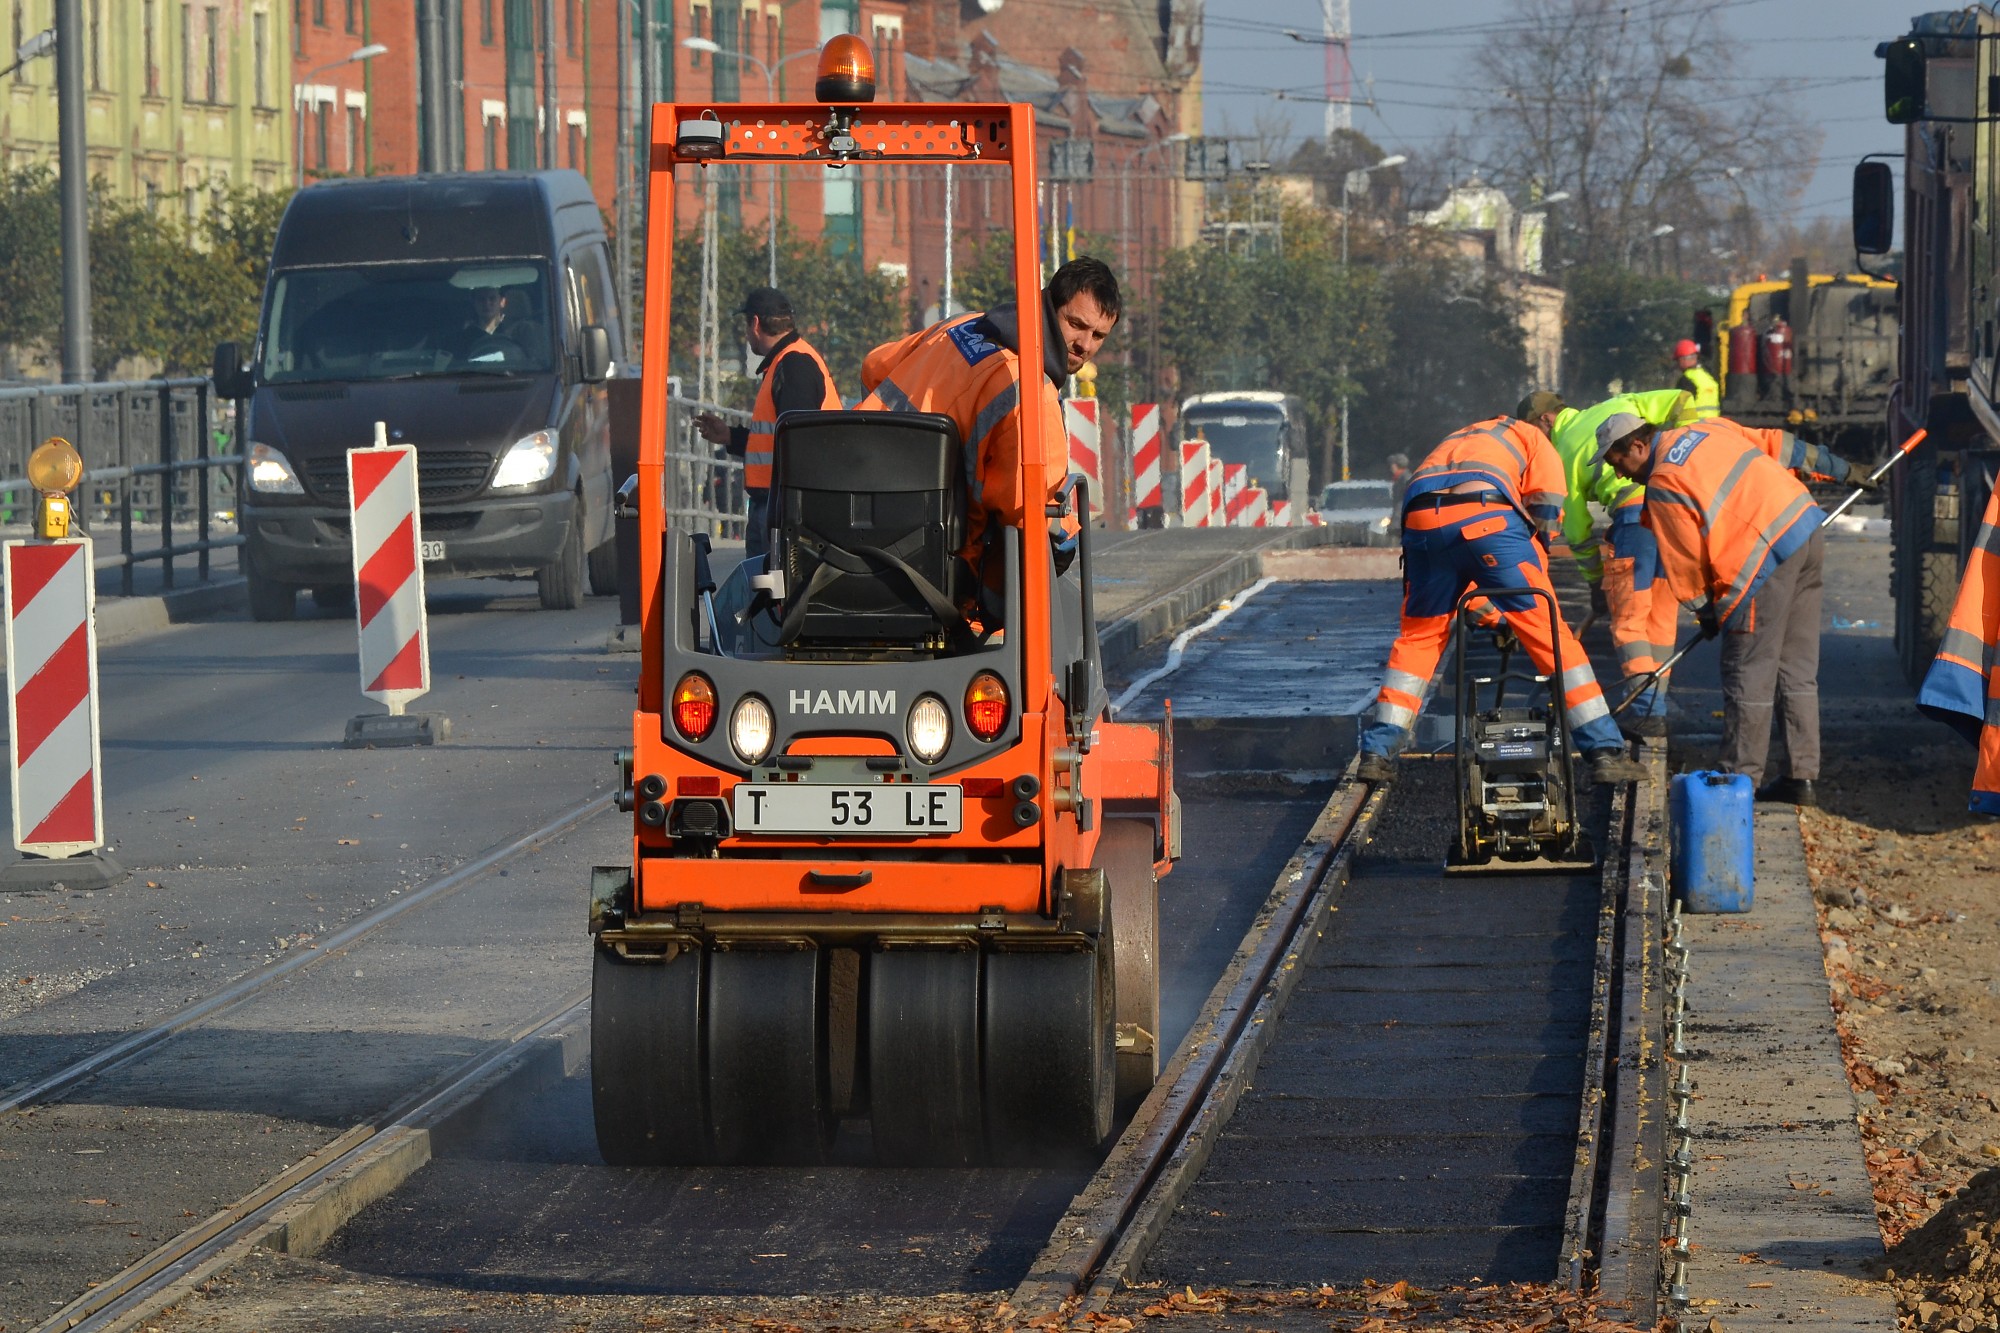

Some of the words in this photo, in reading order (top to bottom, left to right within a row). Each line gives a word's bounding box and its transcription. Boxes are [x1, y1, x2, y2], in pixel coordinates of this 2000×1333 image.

[789, 689, 896, 715] HAMM
[747, 790, 767, 825] T
[831, 790, 873, 826] 53
[905, 791, 948, 826] LE
